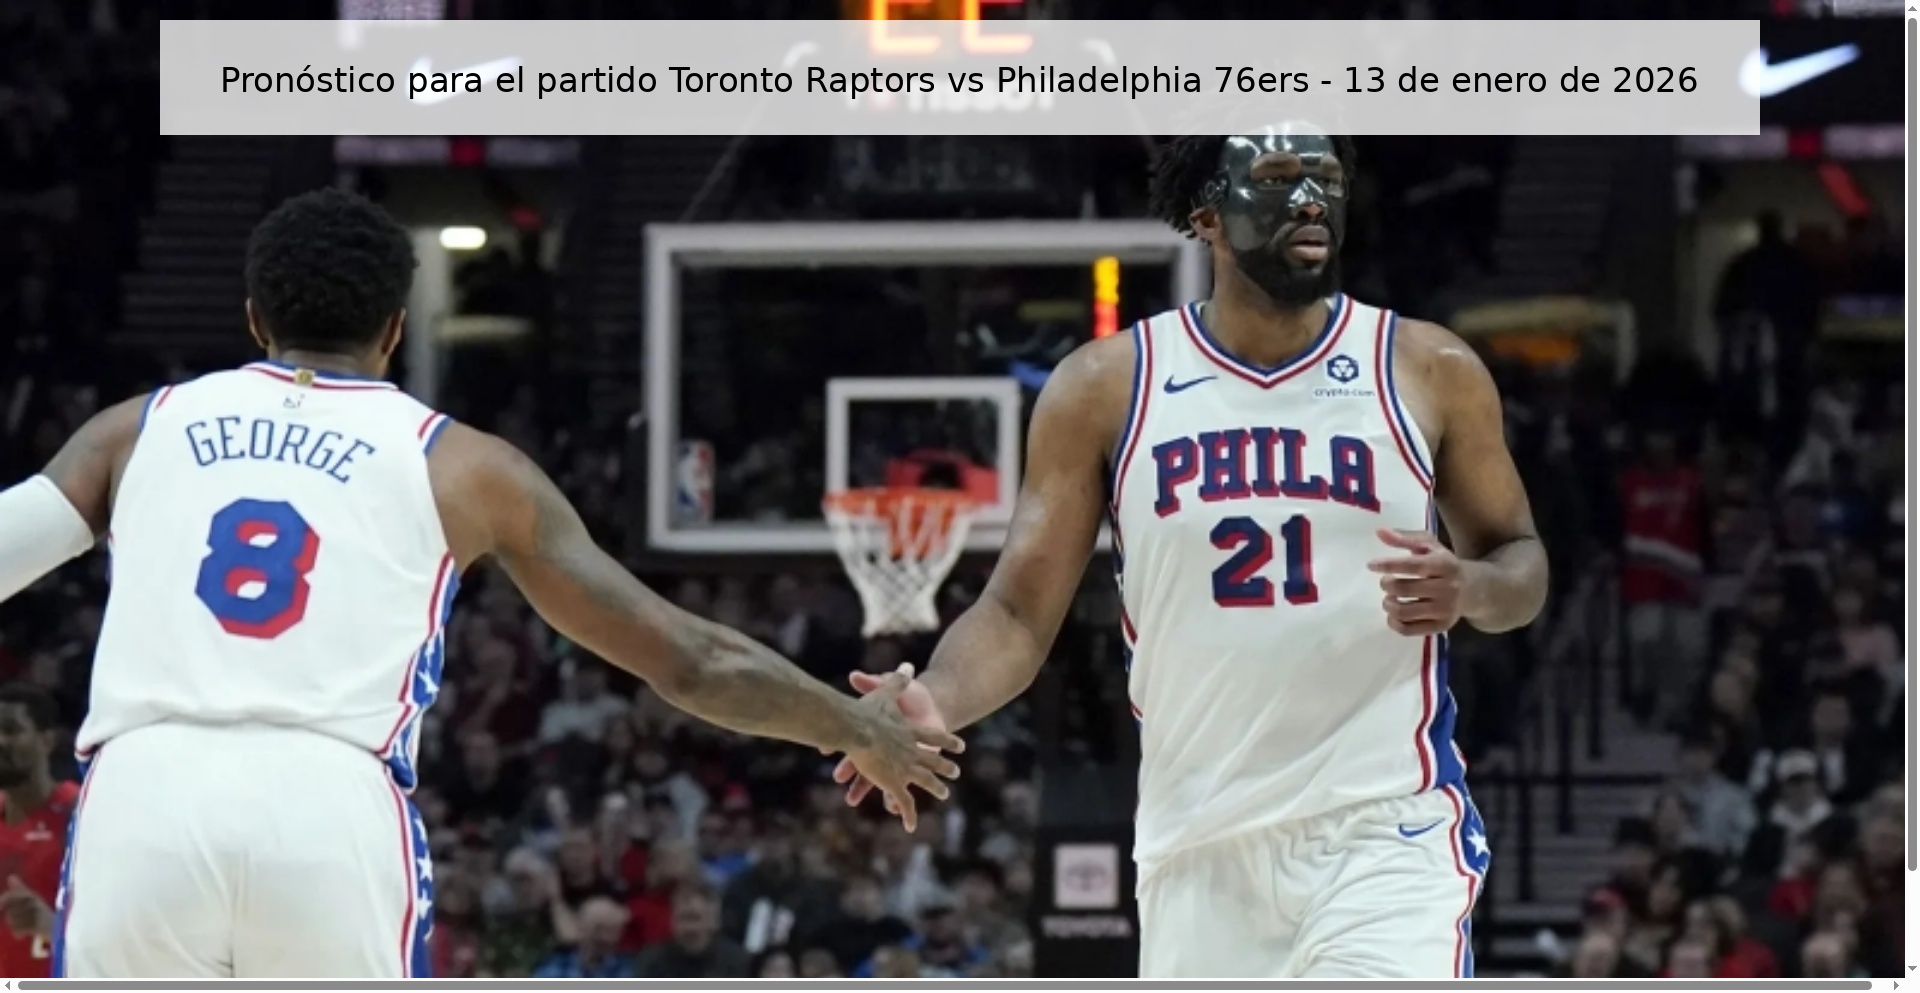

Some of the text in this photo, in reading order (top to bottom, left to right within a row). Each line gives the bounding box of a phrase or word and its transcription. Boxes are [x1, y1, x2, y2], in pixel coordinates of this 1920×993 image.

[185, 415, 376, 484] GEORGE
[1151, 426, 1381, 519] PHILA
[194, 496, 320, 639] 8
[1209, 514, 1319, 608] 21
